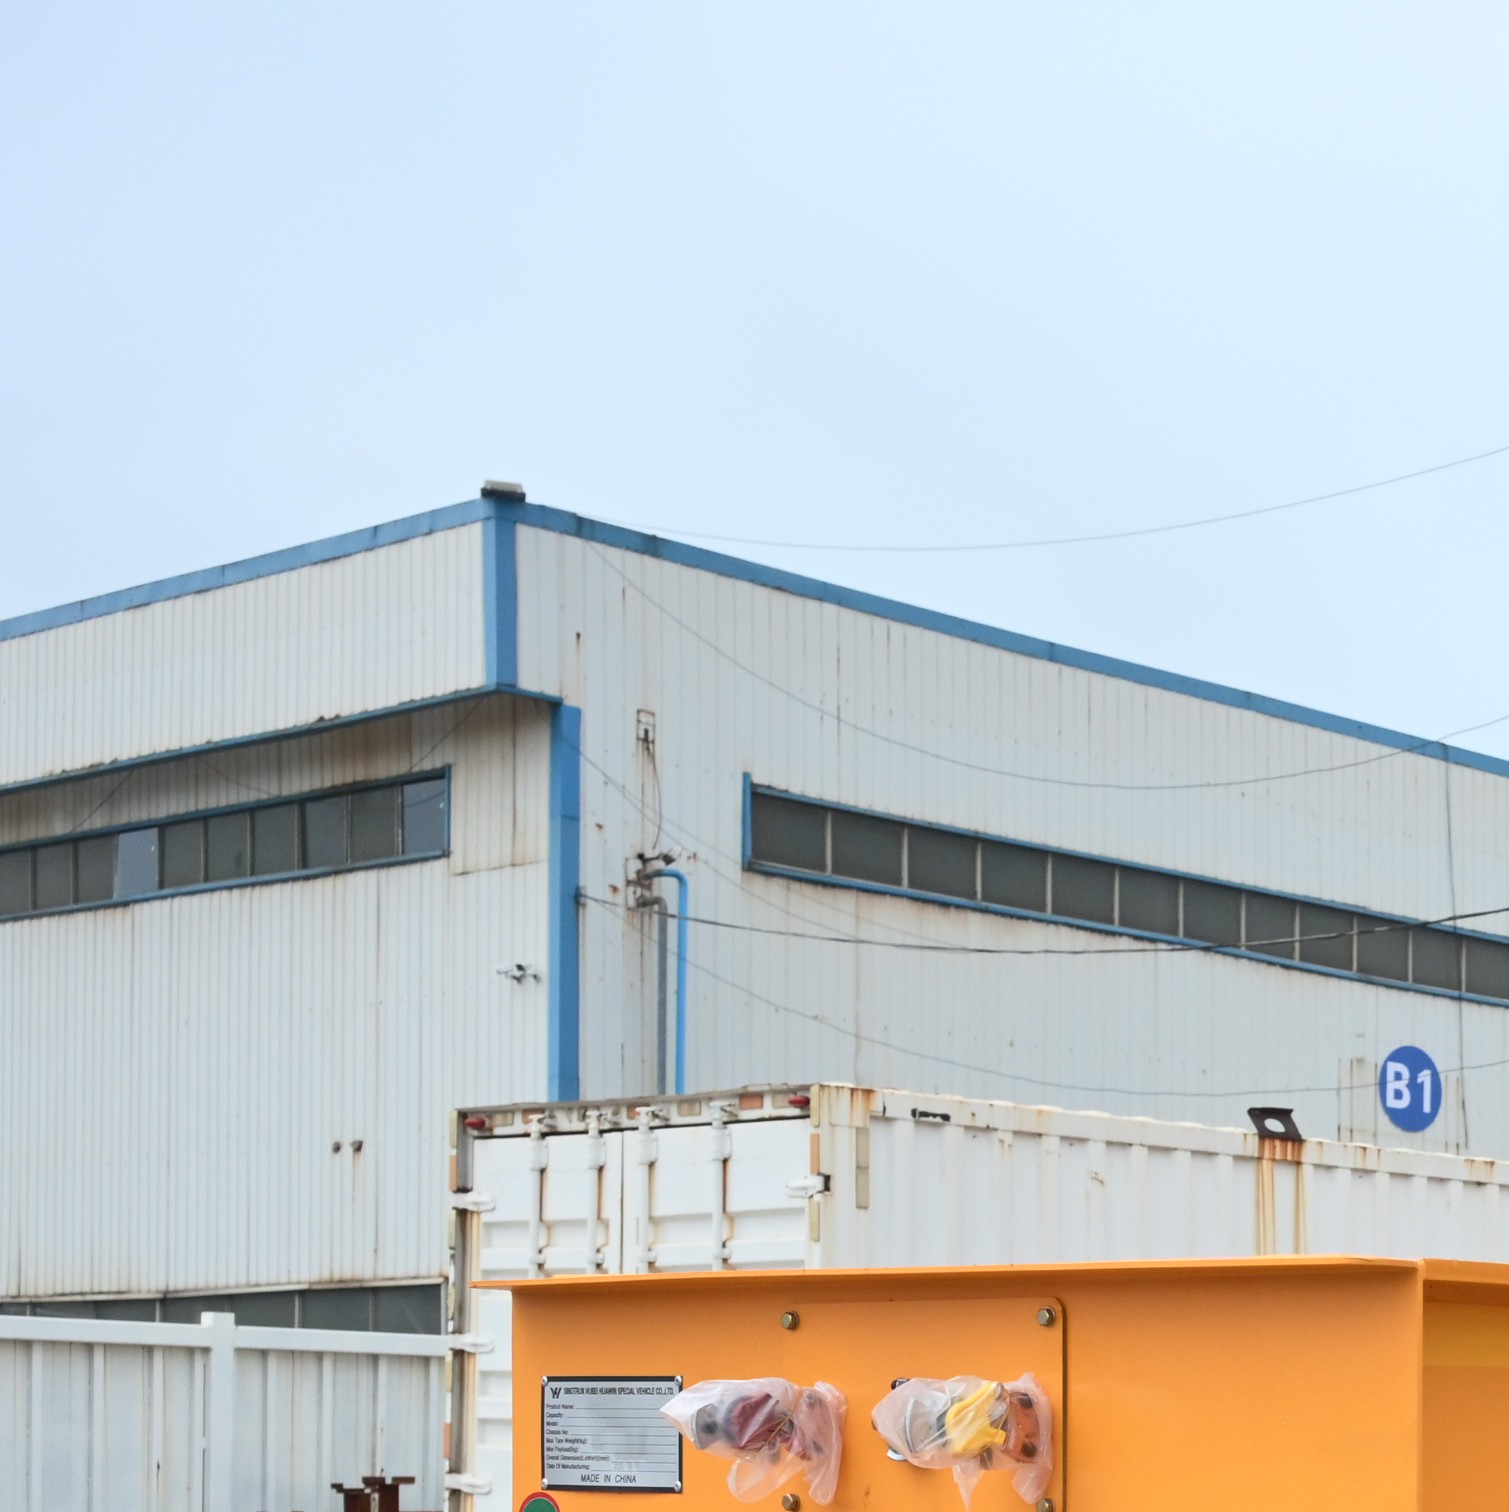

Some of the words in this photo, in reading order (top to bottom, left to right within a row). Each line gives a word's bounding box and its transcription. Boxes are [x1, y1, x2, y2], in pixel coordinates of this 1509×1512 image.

[1386, 1061, 1432, 1114] B1
[617, 1387, 636, 1395] SPECIAL
[636, 1387, 655, 1395] VEHICLE
[580, 1473, 600, 1483] MADE
[603, 1474, 612, 1483] IN
[614, 1474, 637, 1484] CHINA
